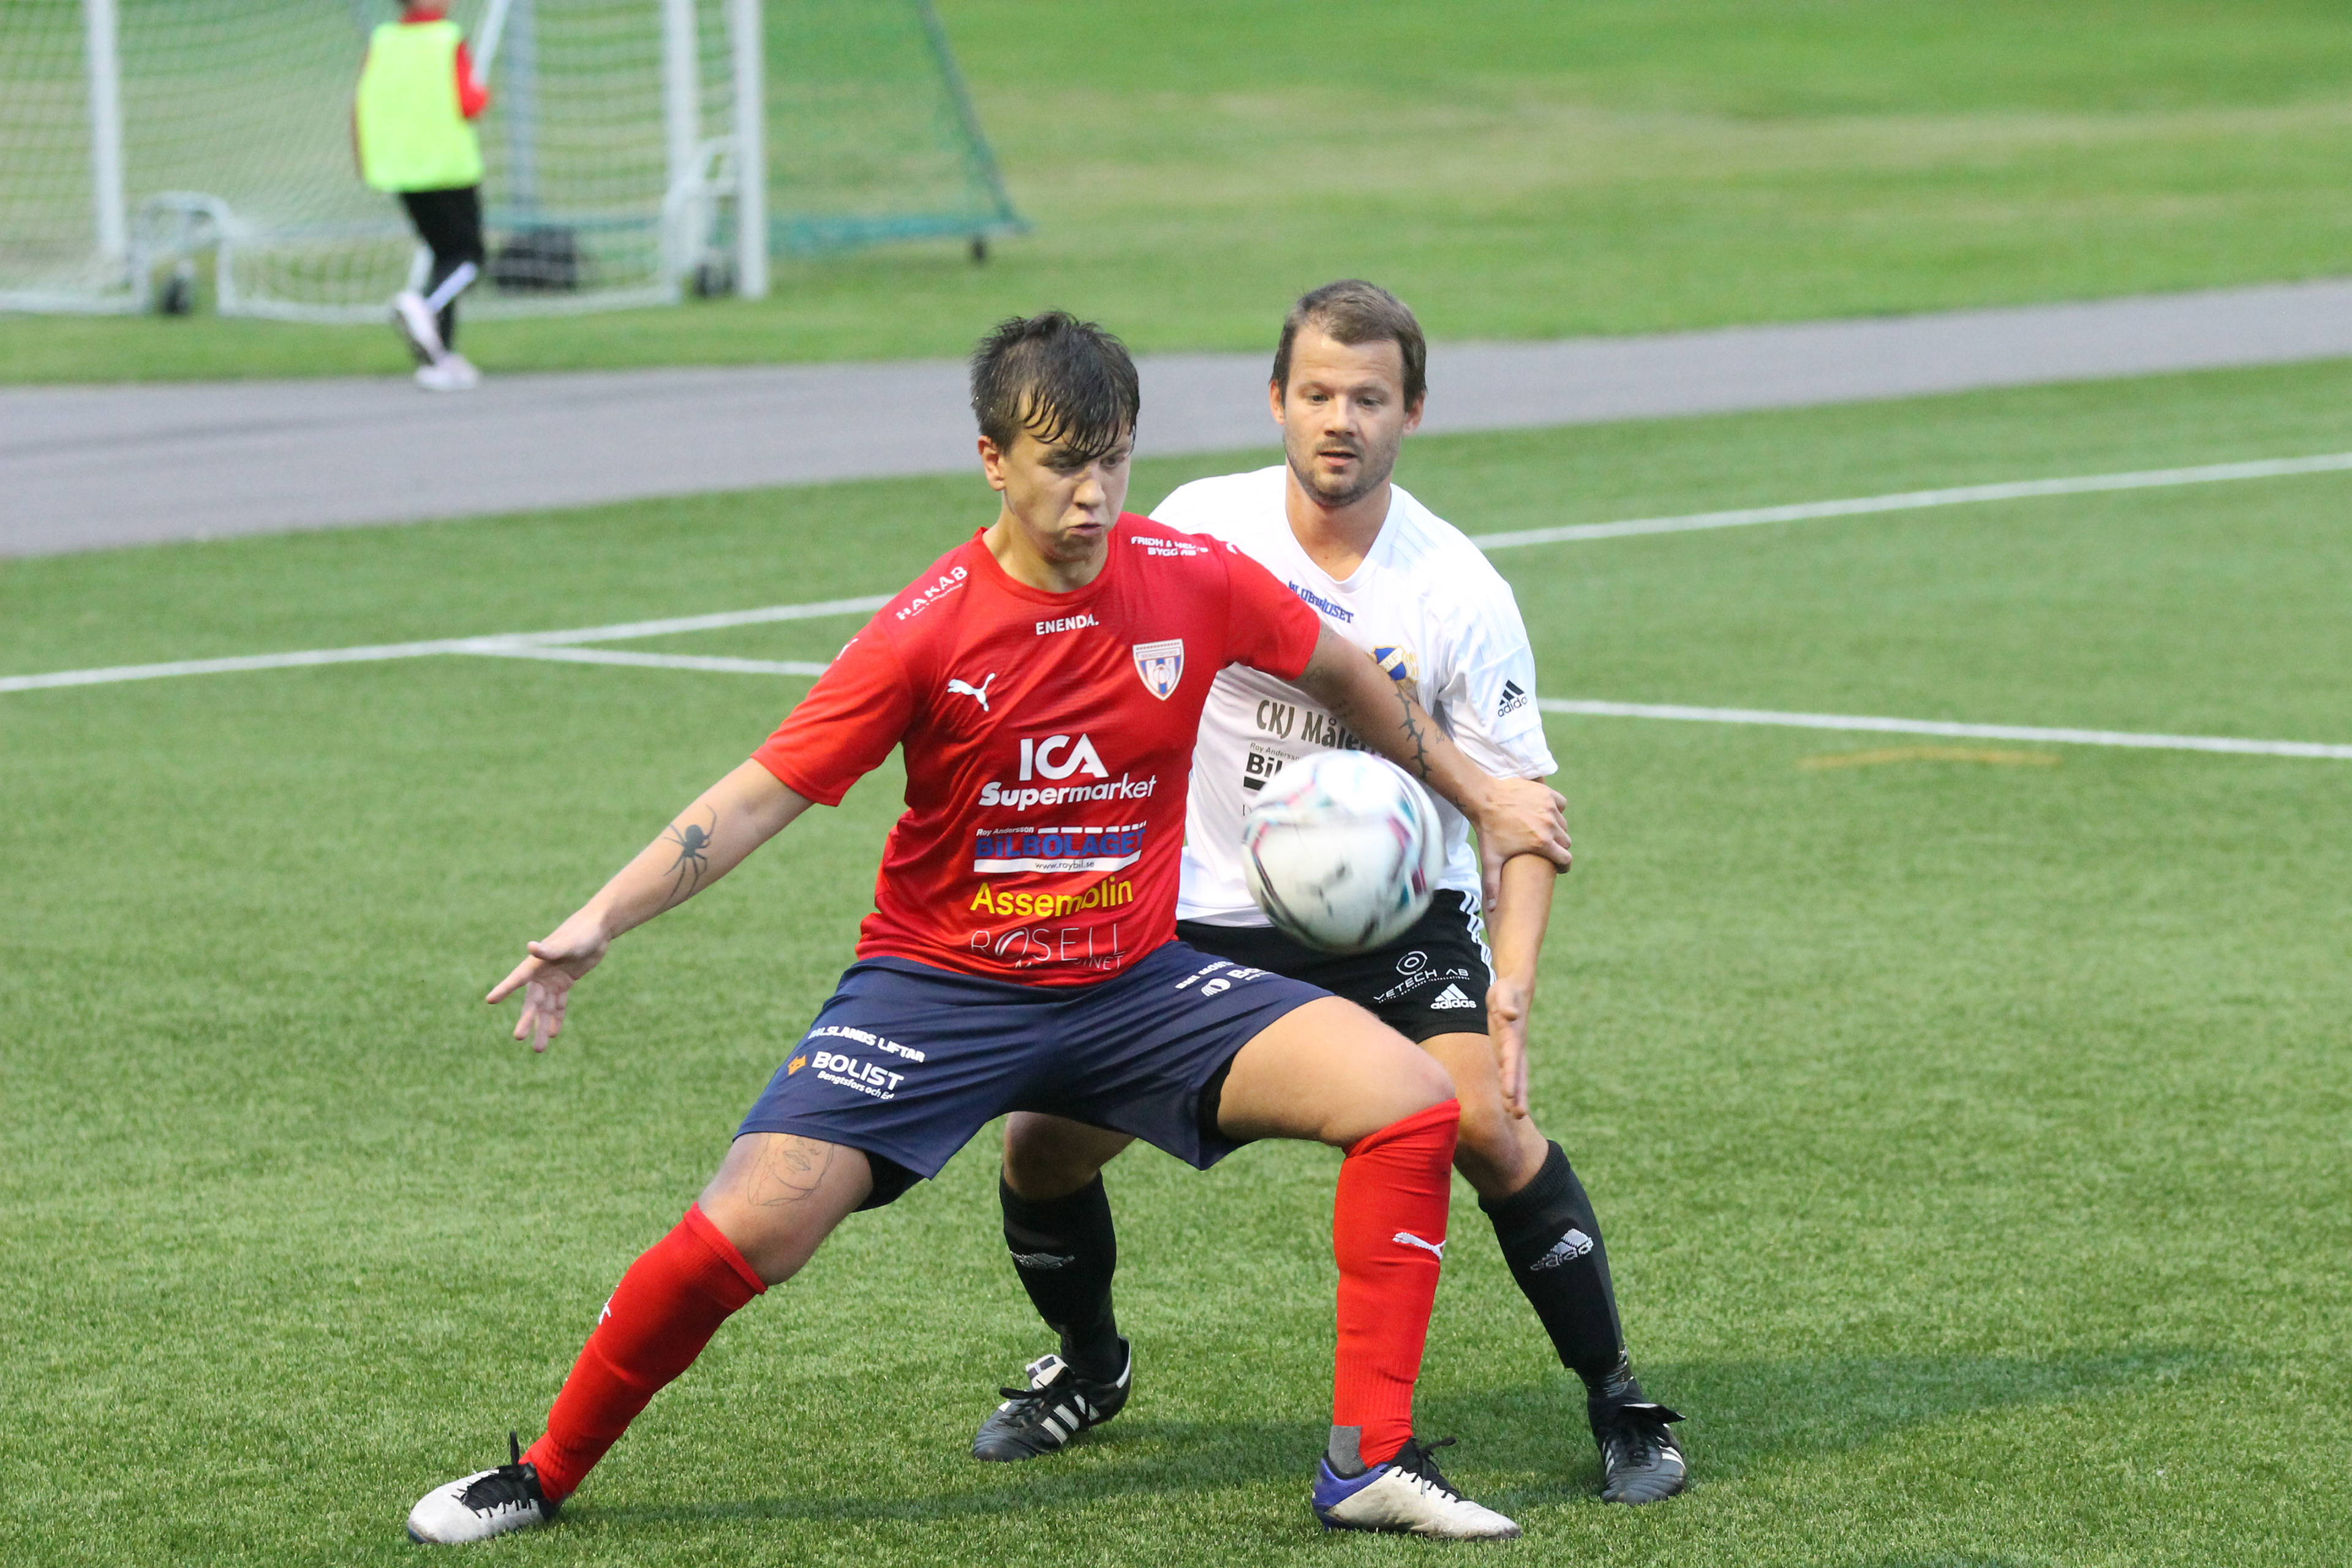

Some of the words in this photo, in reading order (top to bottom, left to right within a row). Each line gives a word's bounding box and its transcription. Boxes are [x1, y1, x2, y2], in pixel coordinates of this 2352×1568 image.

[1147, 547, 1178, 556] BYGG
[896, 567, 968, 620] HAKAB
[1256, 699, 1295, 739] CKJ
[1498, 696, 1528, 717] adida
[1019, 733, 1109, 781] ICA
[1250, 742, 1264, 753] Roy
[1265, 748, 1302, 761] Andersso
[978, 772, 1157, 812] Supermarket
[976, 827, 992, 837] Roy
[993, 826, 1034, 835] Andersson
[1035, 860, 1095, 872] www.roybil.se
[1373, 969, 1438, 1000] VETECH
[1430, 999, 1477, 1009] adidas
[877, 1038, 925, 1063] LIFTAR
[811, 1051, 905, 1091] BOLIST
[816, 1071, 865, 1092] Bengtsfors
[865, 1087, 881, 1098] och
